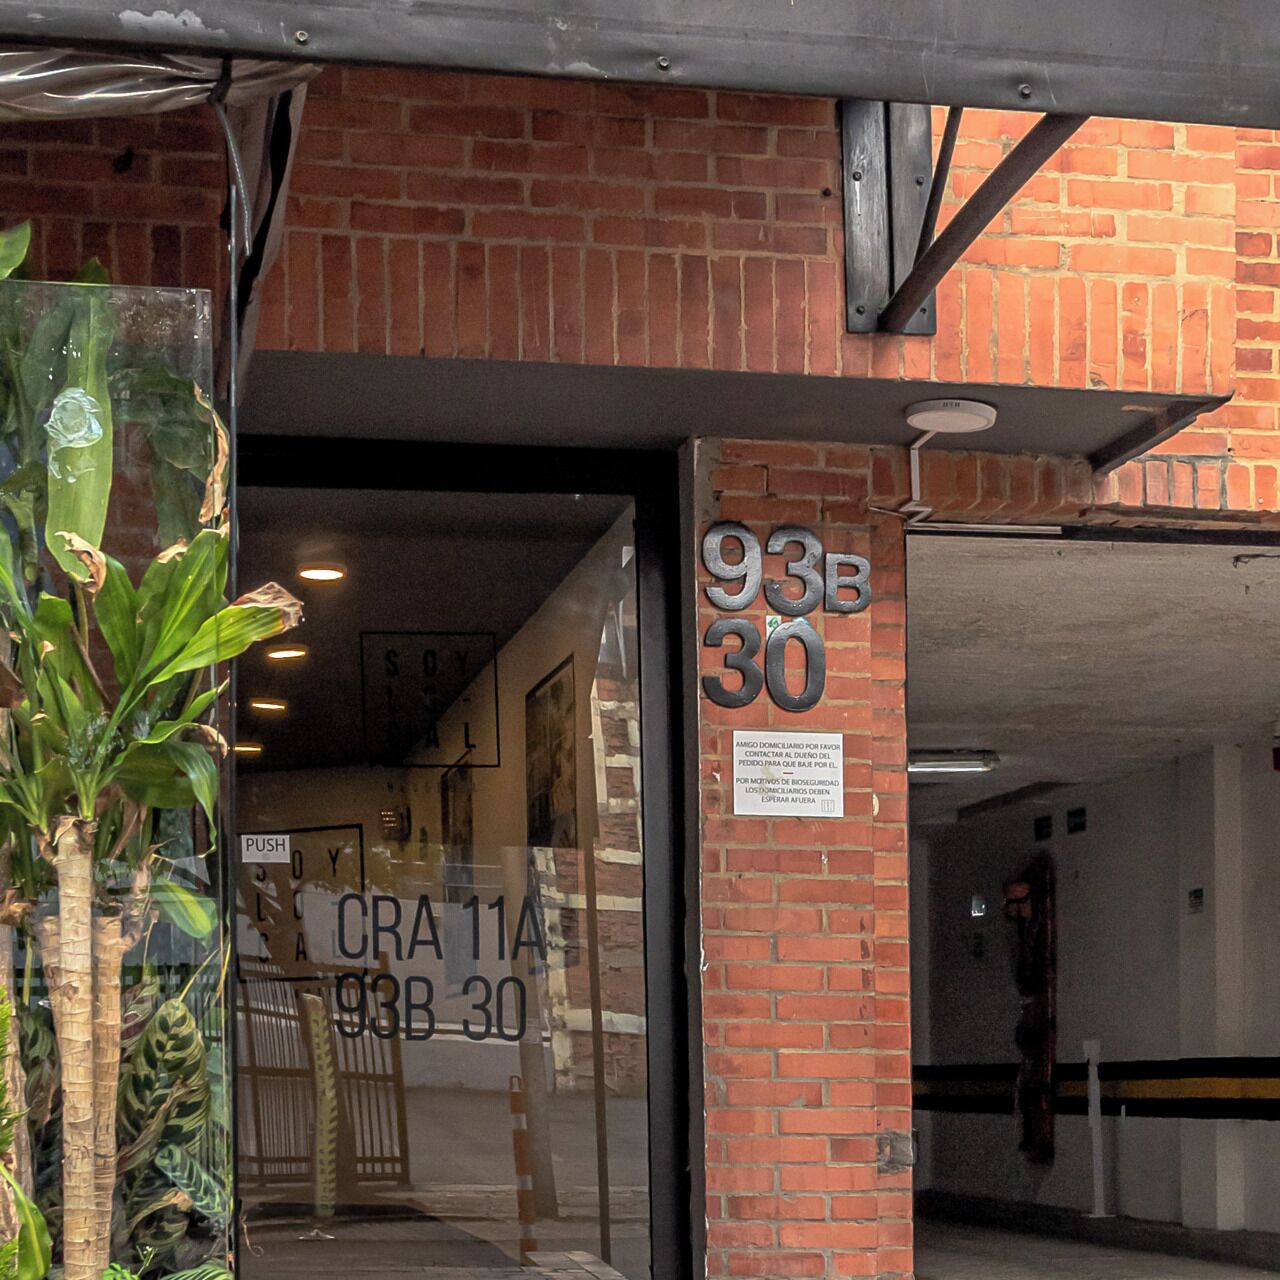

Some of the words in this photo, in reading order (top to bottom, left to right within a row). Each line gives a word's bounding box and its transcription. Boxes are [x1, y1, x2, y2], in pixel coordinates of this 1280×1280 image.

[702, 520, 872, 616] 93B
[702, 617, 826, 713] 30
[759, 742, 804, 750] DOMICILIARIO
[820, 743, 841, 751] FAVOR
[745, 750, 783, 758] CONTACTAR
[794, 751, 817, 759] DUEÑO
[759, 787, 807, 795] DOMICILIARIOS
[791, 796, 816, 804] AFUERA
[246, 838, 286, 852] PUSH
[338, 893, 443, 960] CRA
[463, 894, 548, 961] 11A
[336, 972, 435, 1041] 93B
[462, 975, 526, 1041] 30
